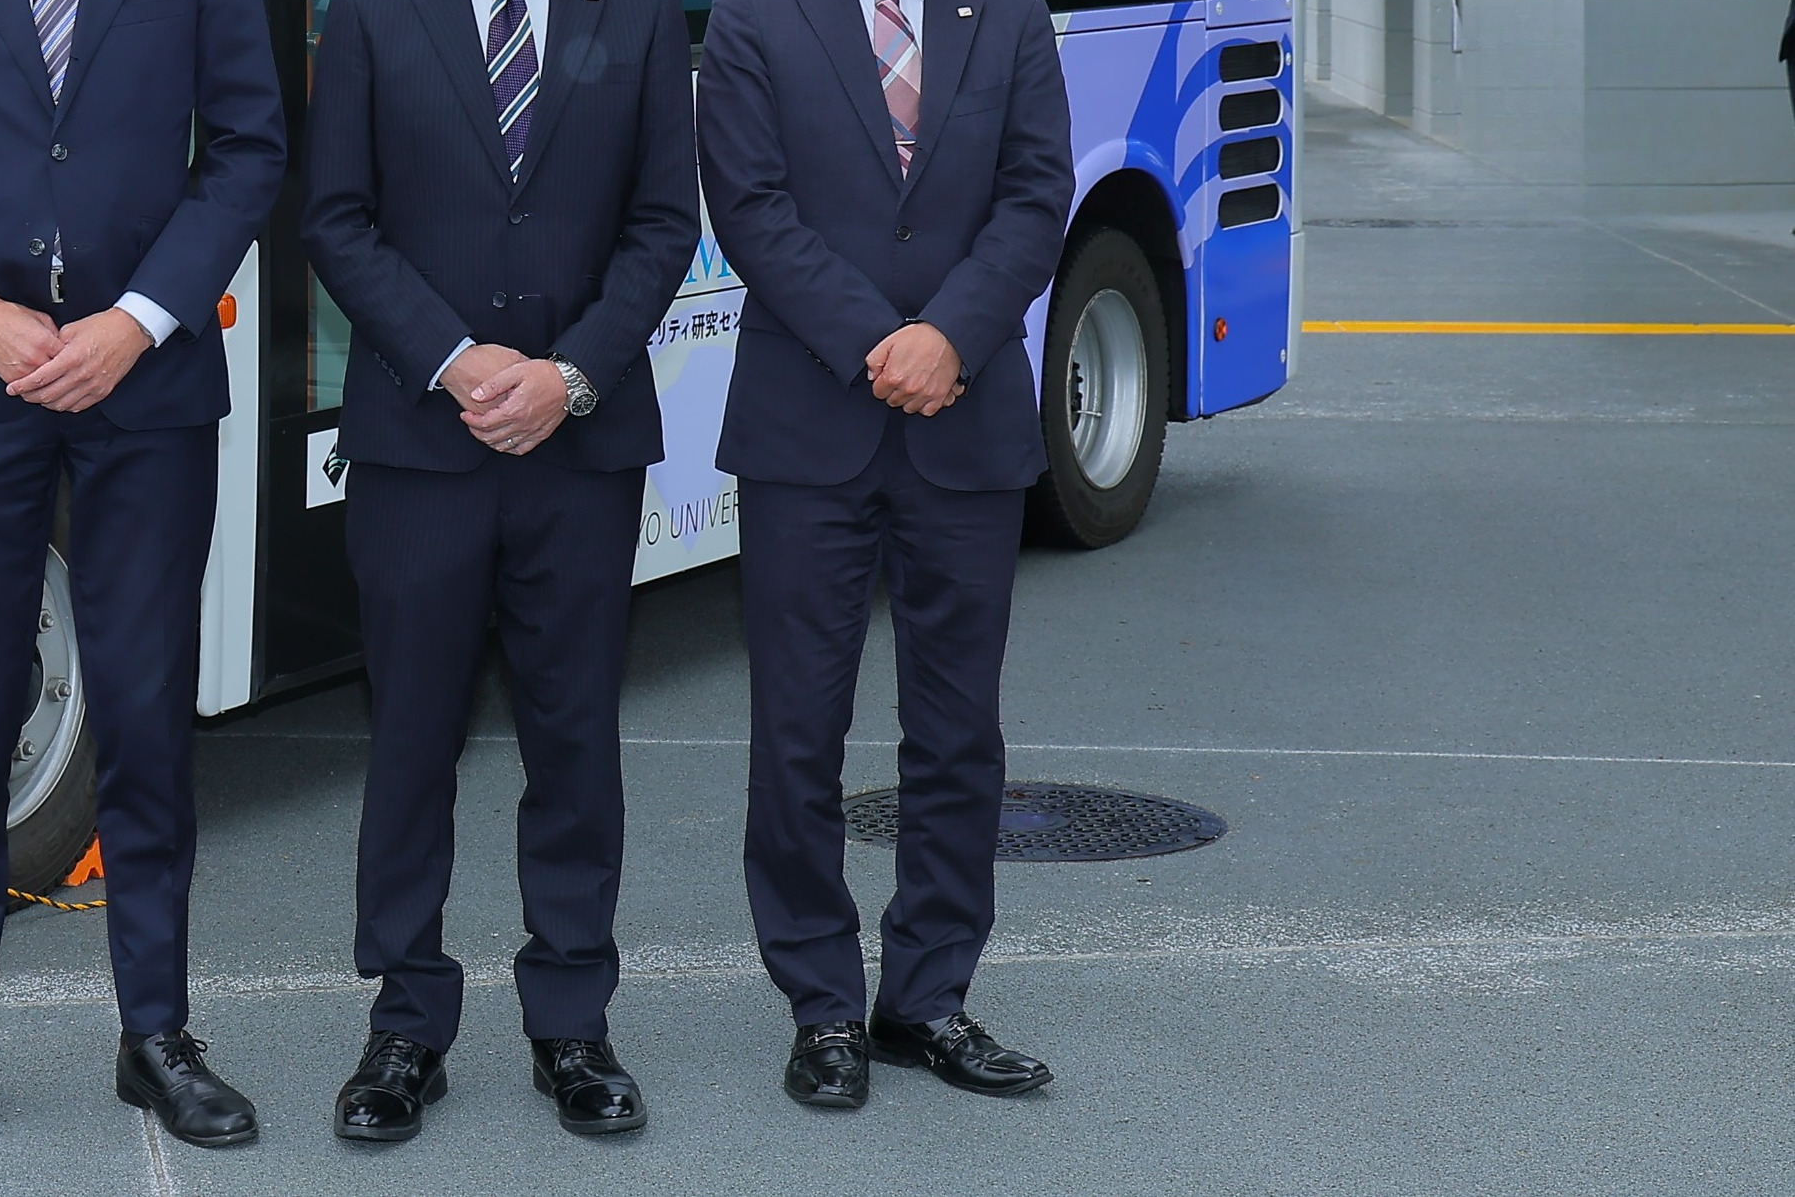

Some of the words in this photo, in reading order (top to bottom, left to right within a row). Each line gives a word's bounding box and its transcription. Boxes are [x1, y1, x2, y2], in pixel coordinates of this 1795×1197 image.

[646, 311, 741, 347] リティ研究セン
